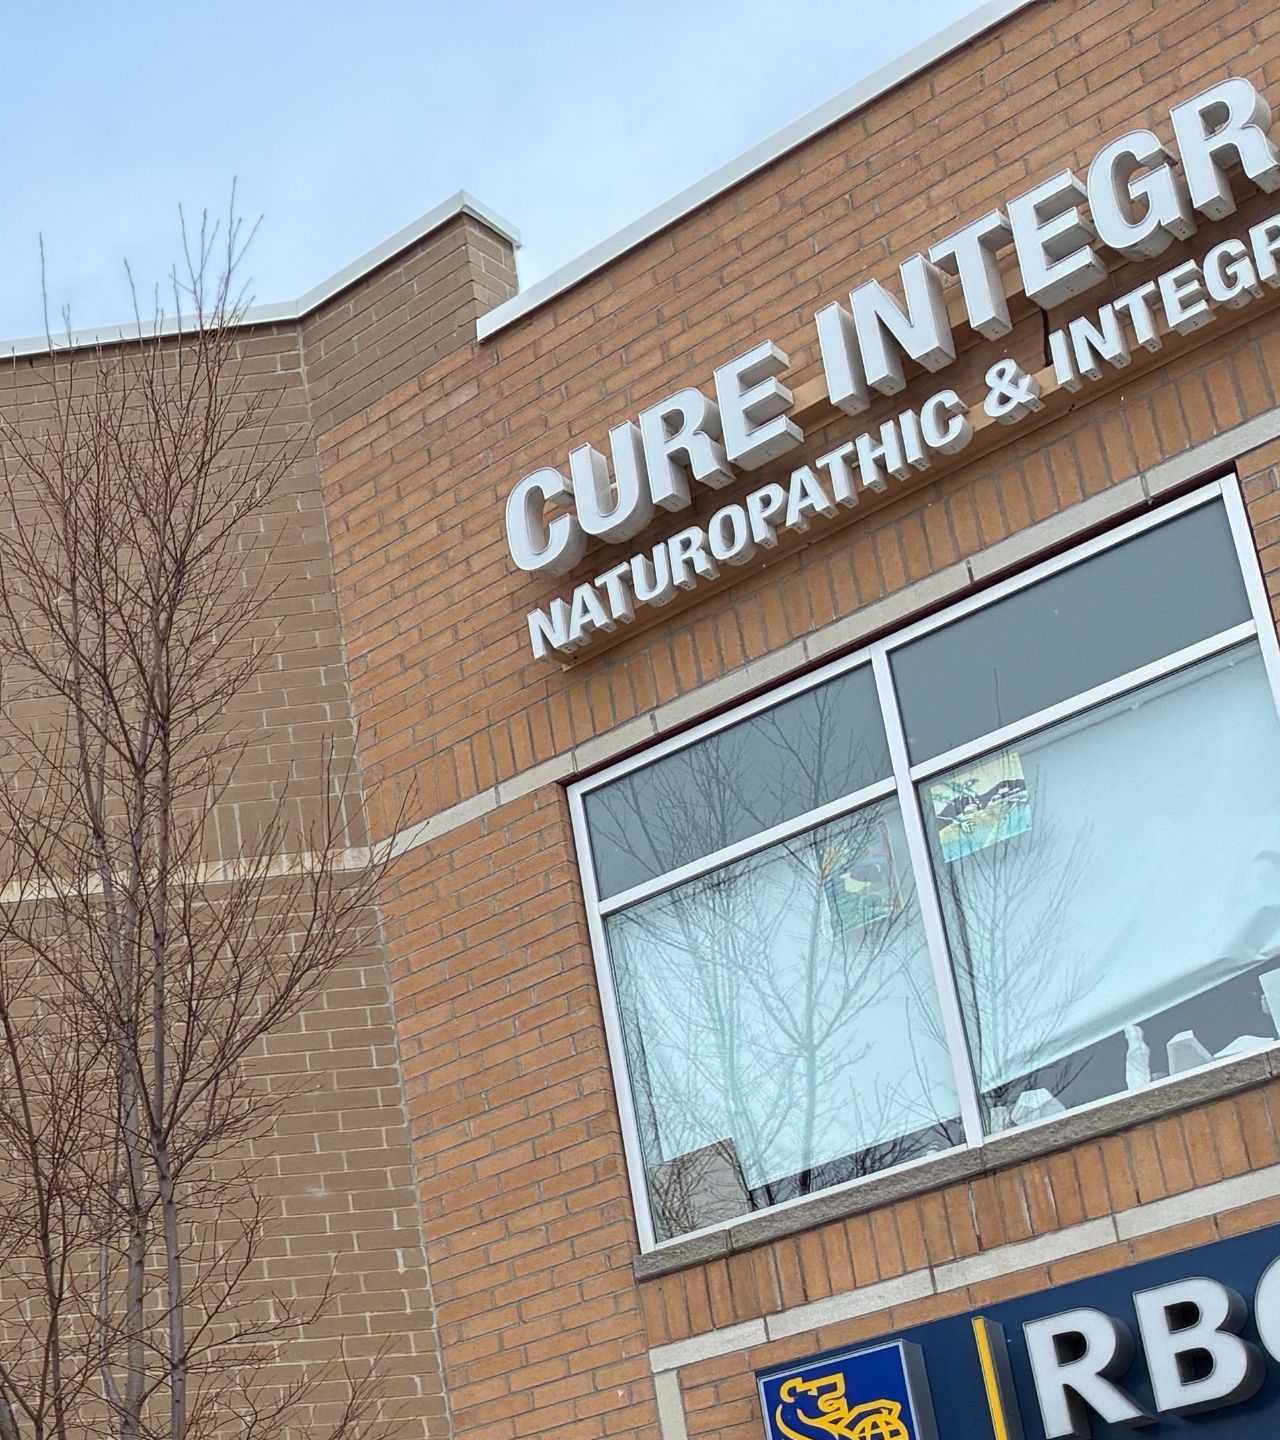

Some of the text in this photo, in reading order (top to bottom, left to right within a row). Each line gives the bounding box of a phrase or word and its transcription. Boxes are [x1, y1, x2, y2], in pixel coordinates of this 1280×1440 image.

[505, 76, 1280, 576] CURE INTEGR
[527, 388, 974, 664] NATUROPATHIC
[982, 357, 1045, 427] &
